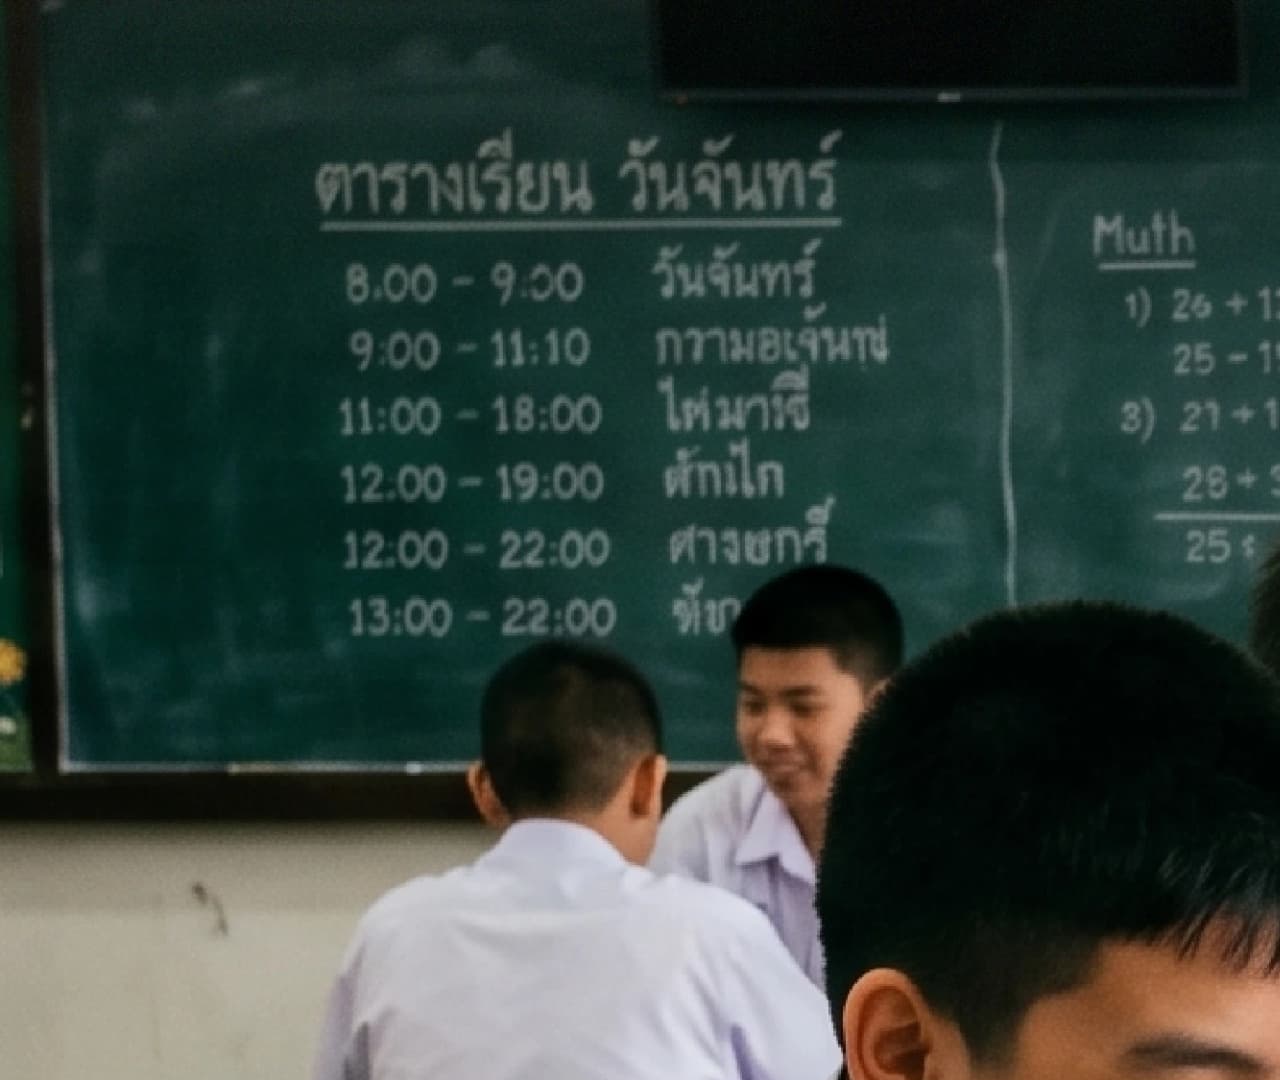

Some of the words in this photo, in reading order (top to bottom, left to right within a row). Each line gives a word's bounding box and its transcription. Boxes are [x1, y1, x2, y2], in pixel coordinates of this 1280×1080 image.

[618, 131, 841, 212] วันจันทร์
[491, 327, 591, 368] 11:10
[1173, 342, 1215, 376] 25
[339, 396, 442, 436] 11:00
[493, 394, 603, 434] 18:00
[499, 529, 611, 569] 22:00
[1186, 527, 1232, 564] 25
[350, 597, 454, 638] 13:00
[501, 597, 618, 638] 22:00
